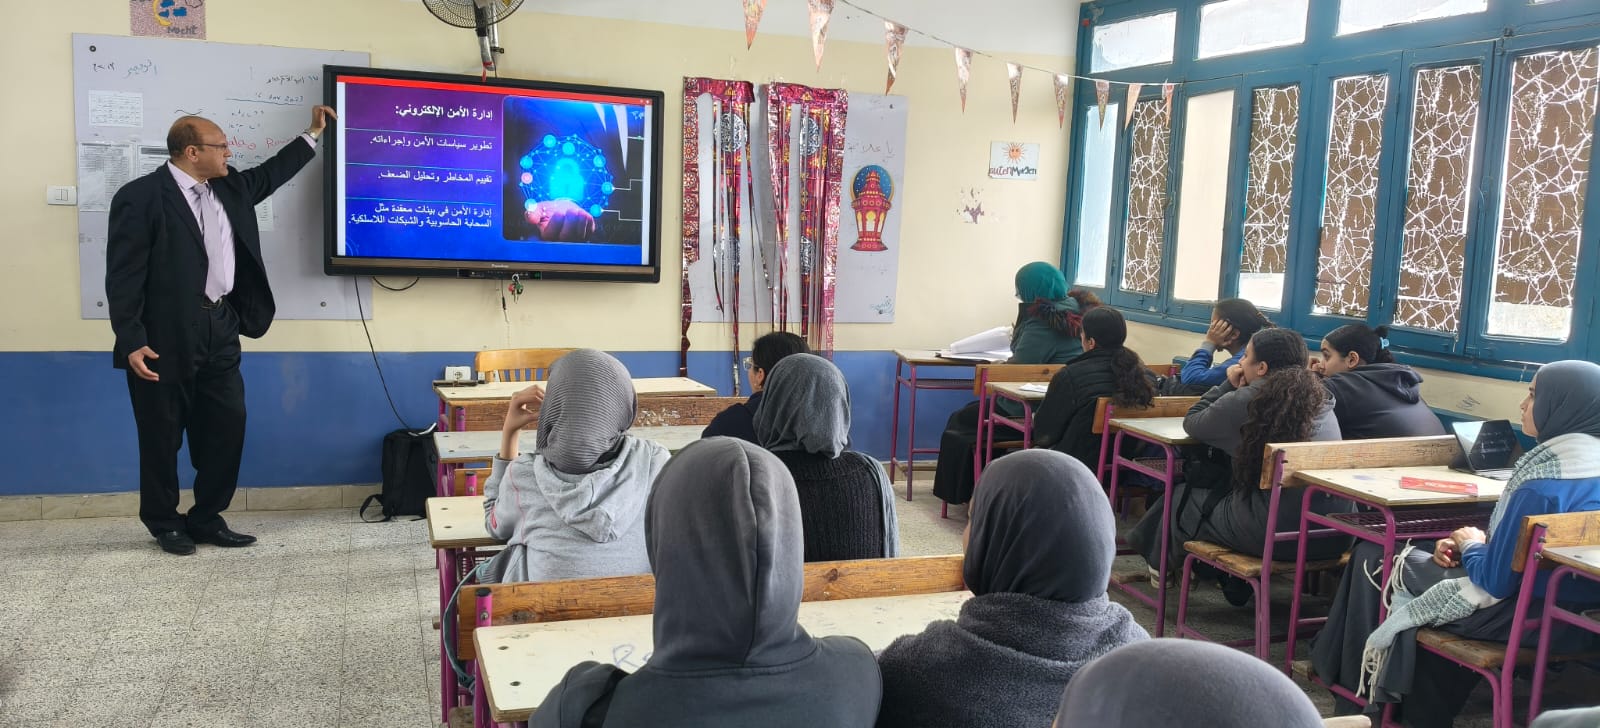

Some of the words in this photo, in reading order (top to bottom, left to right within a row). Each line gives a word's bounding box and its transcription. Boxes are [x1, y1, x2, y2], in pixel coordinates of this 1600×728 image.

[395, 104, 444, 118] الإلكتروني:
[447, 105, 470, 118] الأمن
[472, 109, 493, 121] إدارة
[370, 135, 411, 147] وإجراءاته.
[413, 136, 434, 147] الأمن
[436, 139, 467, 150] سياسات
[469, 141, 493, 151] تطوير
[378, 170, 411, 179] الضعف.
[413, 171, 440, 182] وتحليل
[443, 172, 474, 183] المخاطر
[475, 175, 493, 185] تقييم
[374, 203, 390, 213] مثل
[391, 204, 413, 213] معقدة
[437, 206, 449, 217] في
[451, 206, 471, 216] الأمن
[473, 207, 492, 217] إدارة
[348, 213, 385, 224] اللاسلكية.
[387, 215, 424, 227] والشبكات
[426, 216, 462, 227] الحاسوبية
[464, 218, 492, 228] السحابة
